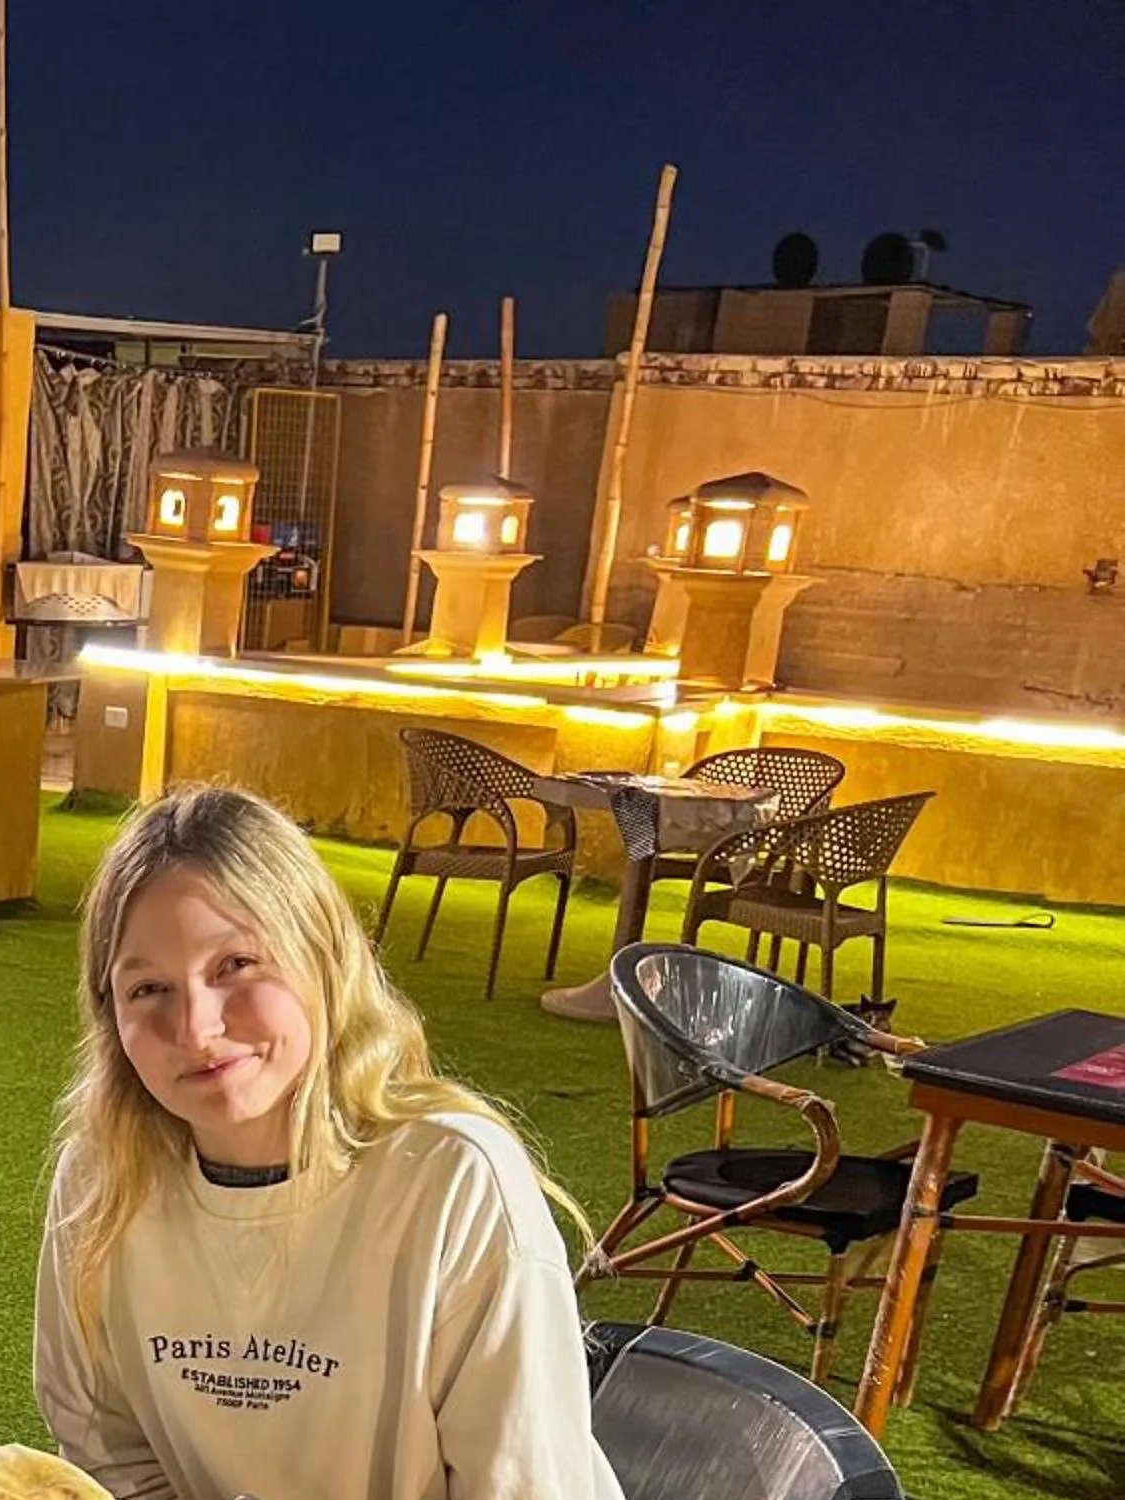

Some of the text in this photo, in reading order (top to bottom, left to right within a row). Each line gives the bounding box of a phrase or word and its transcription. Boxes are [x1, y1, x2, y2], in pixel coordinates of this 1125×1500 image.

[149, 1333, 340, 1377] Paris Atelier
[181, 1368, 270, 1389] ESTABLISHED
